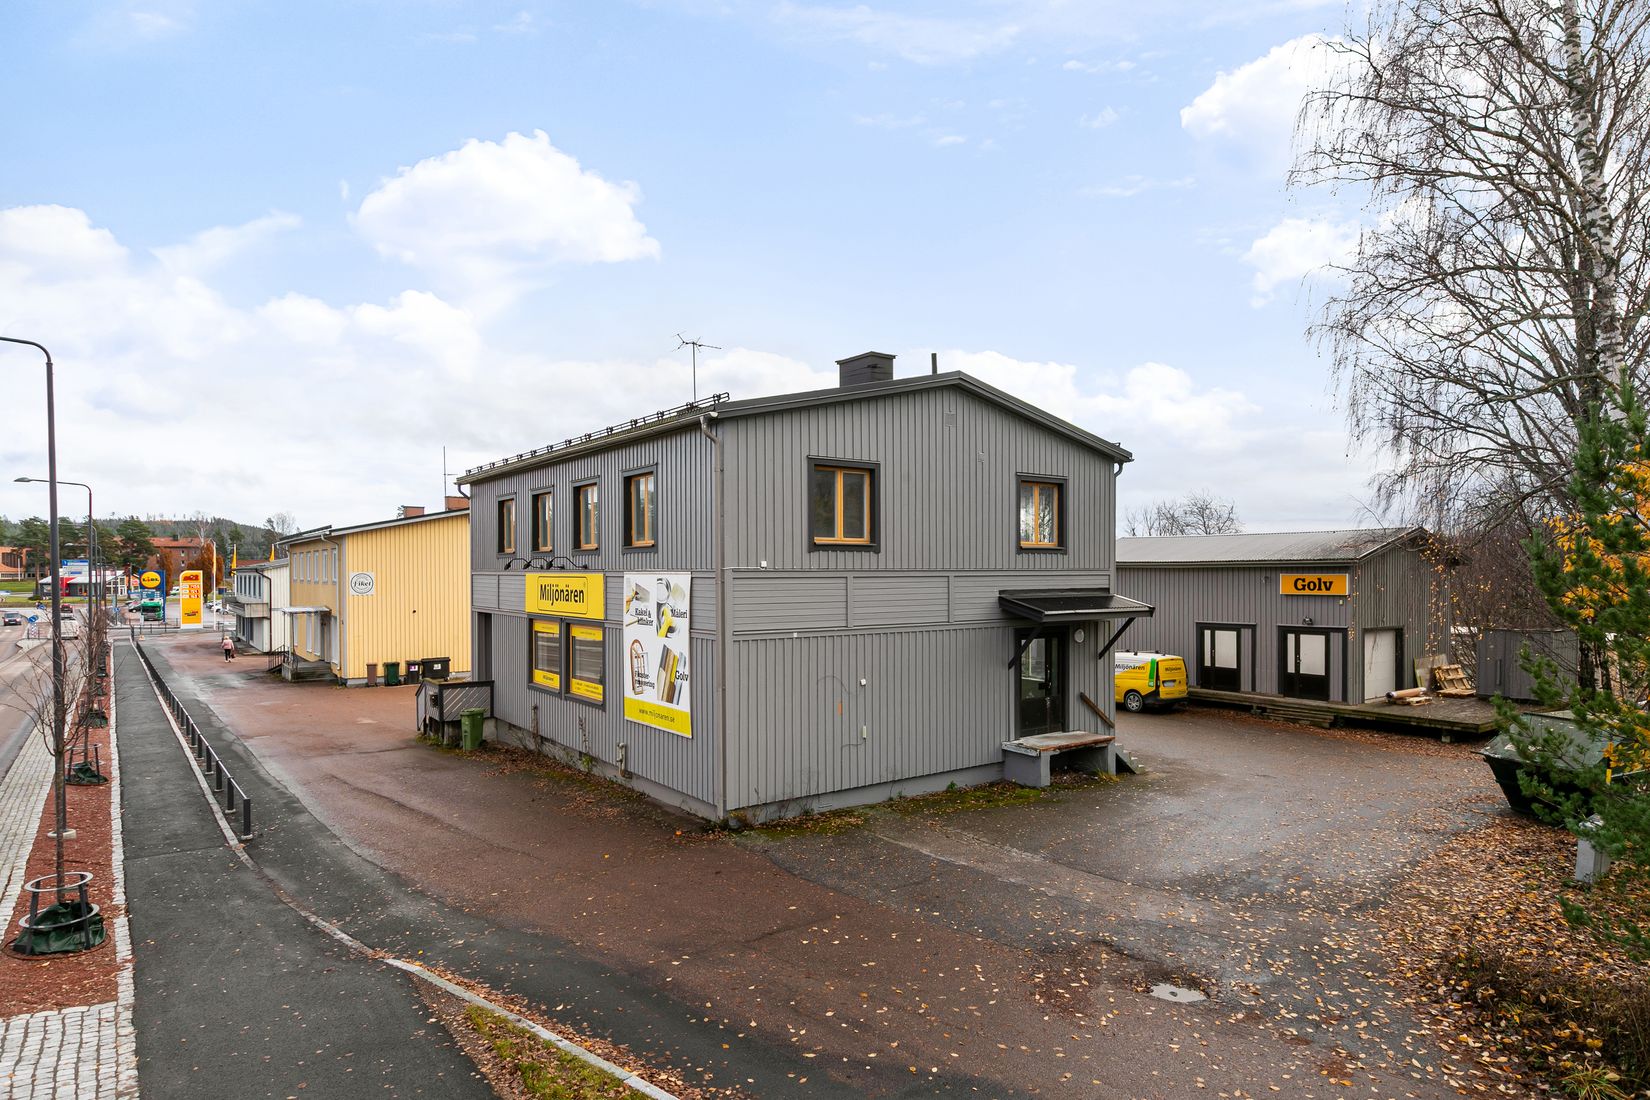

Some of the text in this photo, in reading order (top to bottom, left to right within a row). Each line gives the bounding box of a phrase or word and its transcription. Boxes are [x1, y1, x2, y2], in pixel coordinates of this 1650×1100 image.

[1293, 577, 1334, 592] Golv
[539, 583, 585, 606] Miljönären
[671, 608, 688, 618] Måleri
[675, 670, 689, 681] Golv
